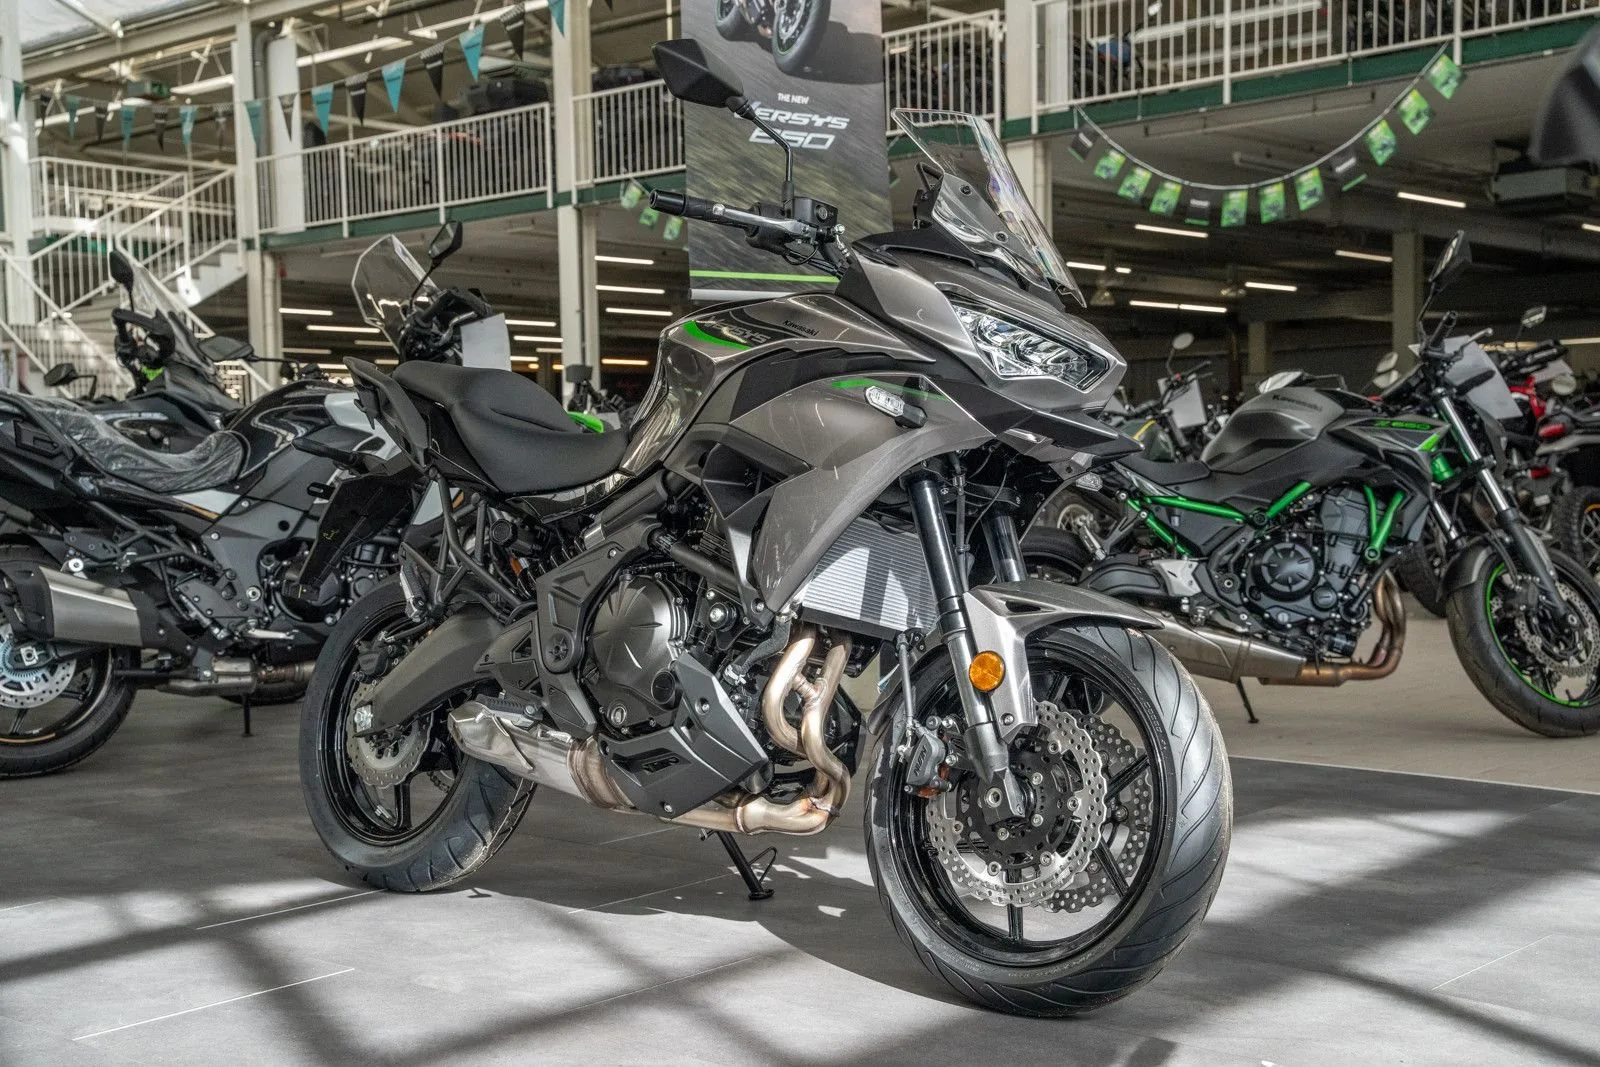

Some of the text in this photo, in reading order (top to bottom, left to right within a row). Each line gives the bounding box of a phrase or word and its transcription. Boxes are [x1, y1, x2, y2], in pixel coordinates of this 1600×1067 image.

[777, 92, 809, 105] THE NEW
[783, 319, 820, 337] Kawasaki
